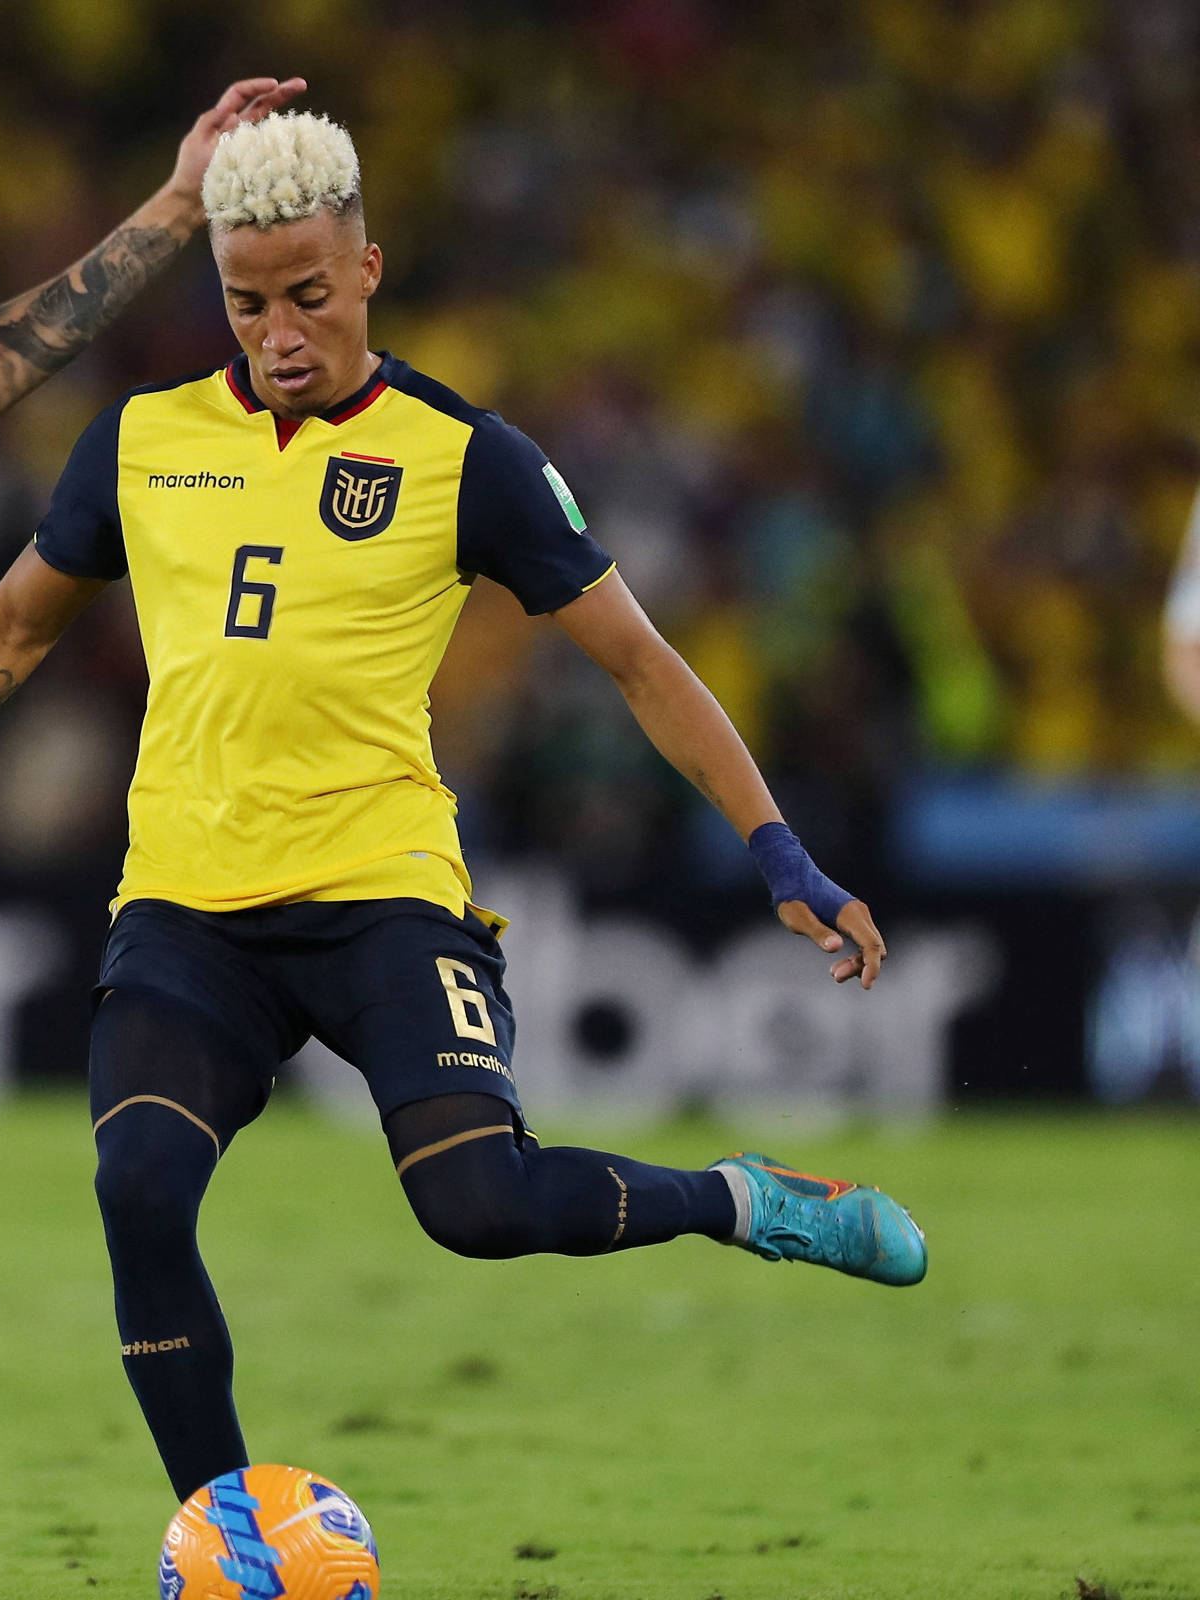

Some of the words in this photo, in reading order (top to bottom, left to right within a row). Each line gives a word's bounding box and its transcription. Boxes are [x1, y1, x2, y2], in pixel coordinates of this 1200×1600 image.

[148, 471, 245, 490] marathon
[224, 545, 284, 640] 6
[435, 956, 497, 1048] 6
